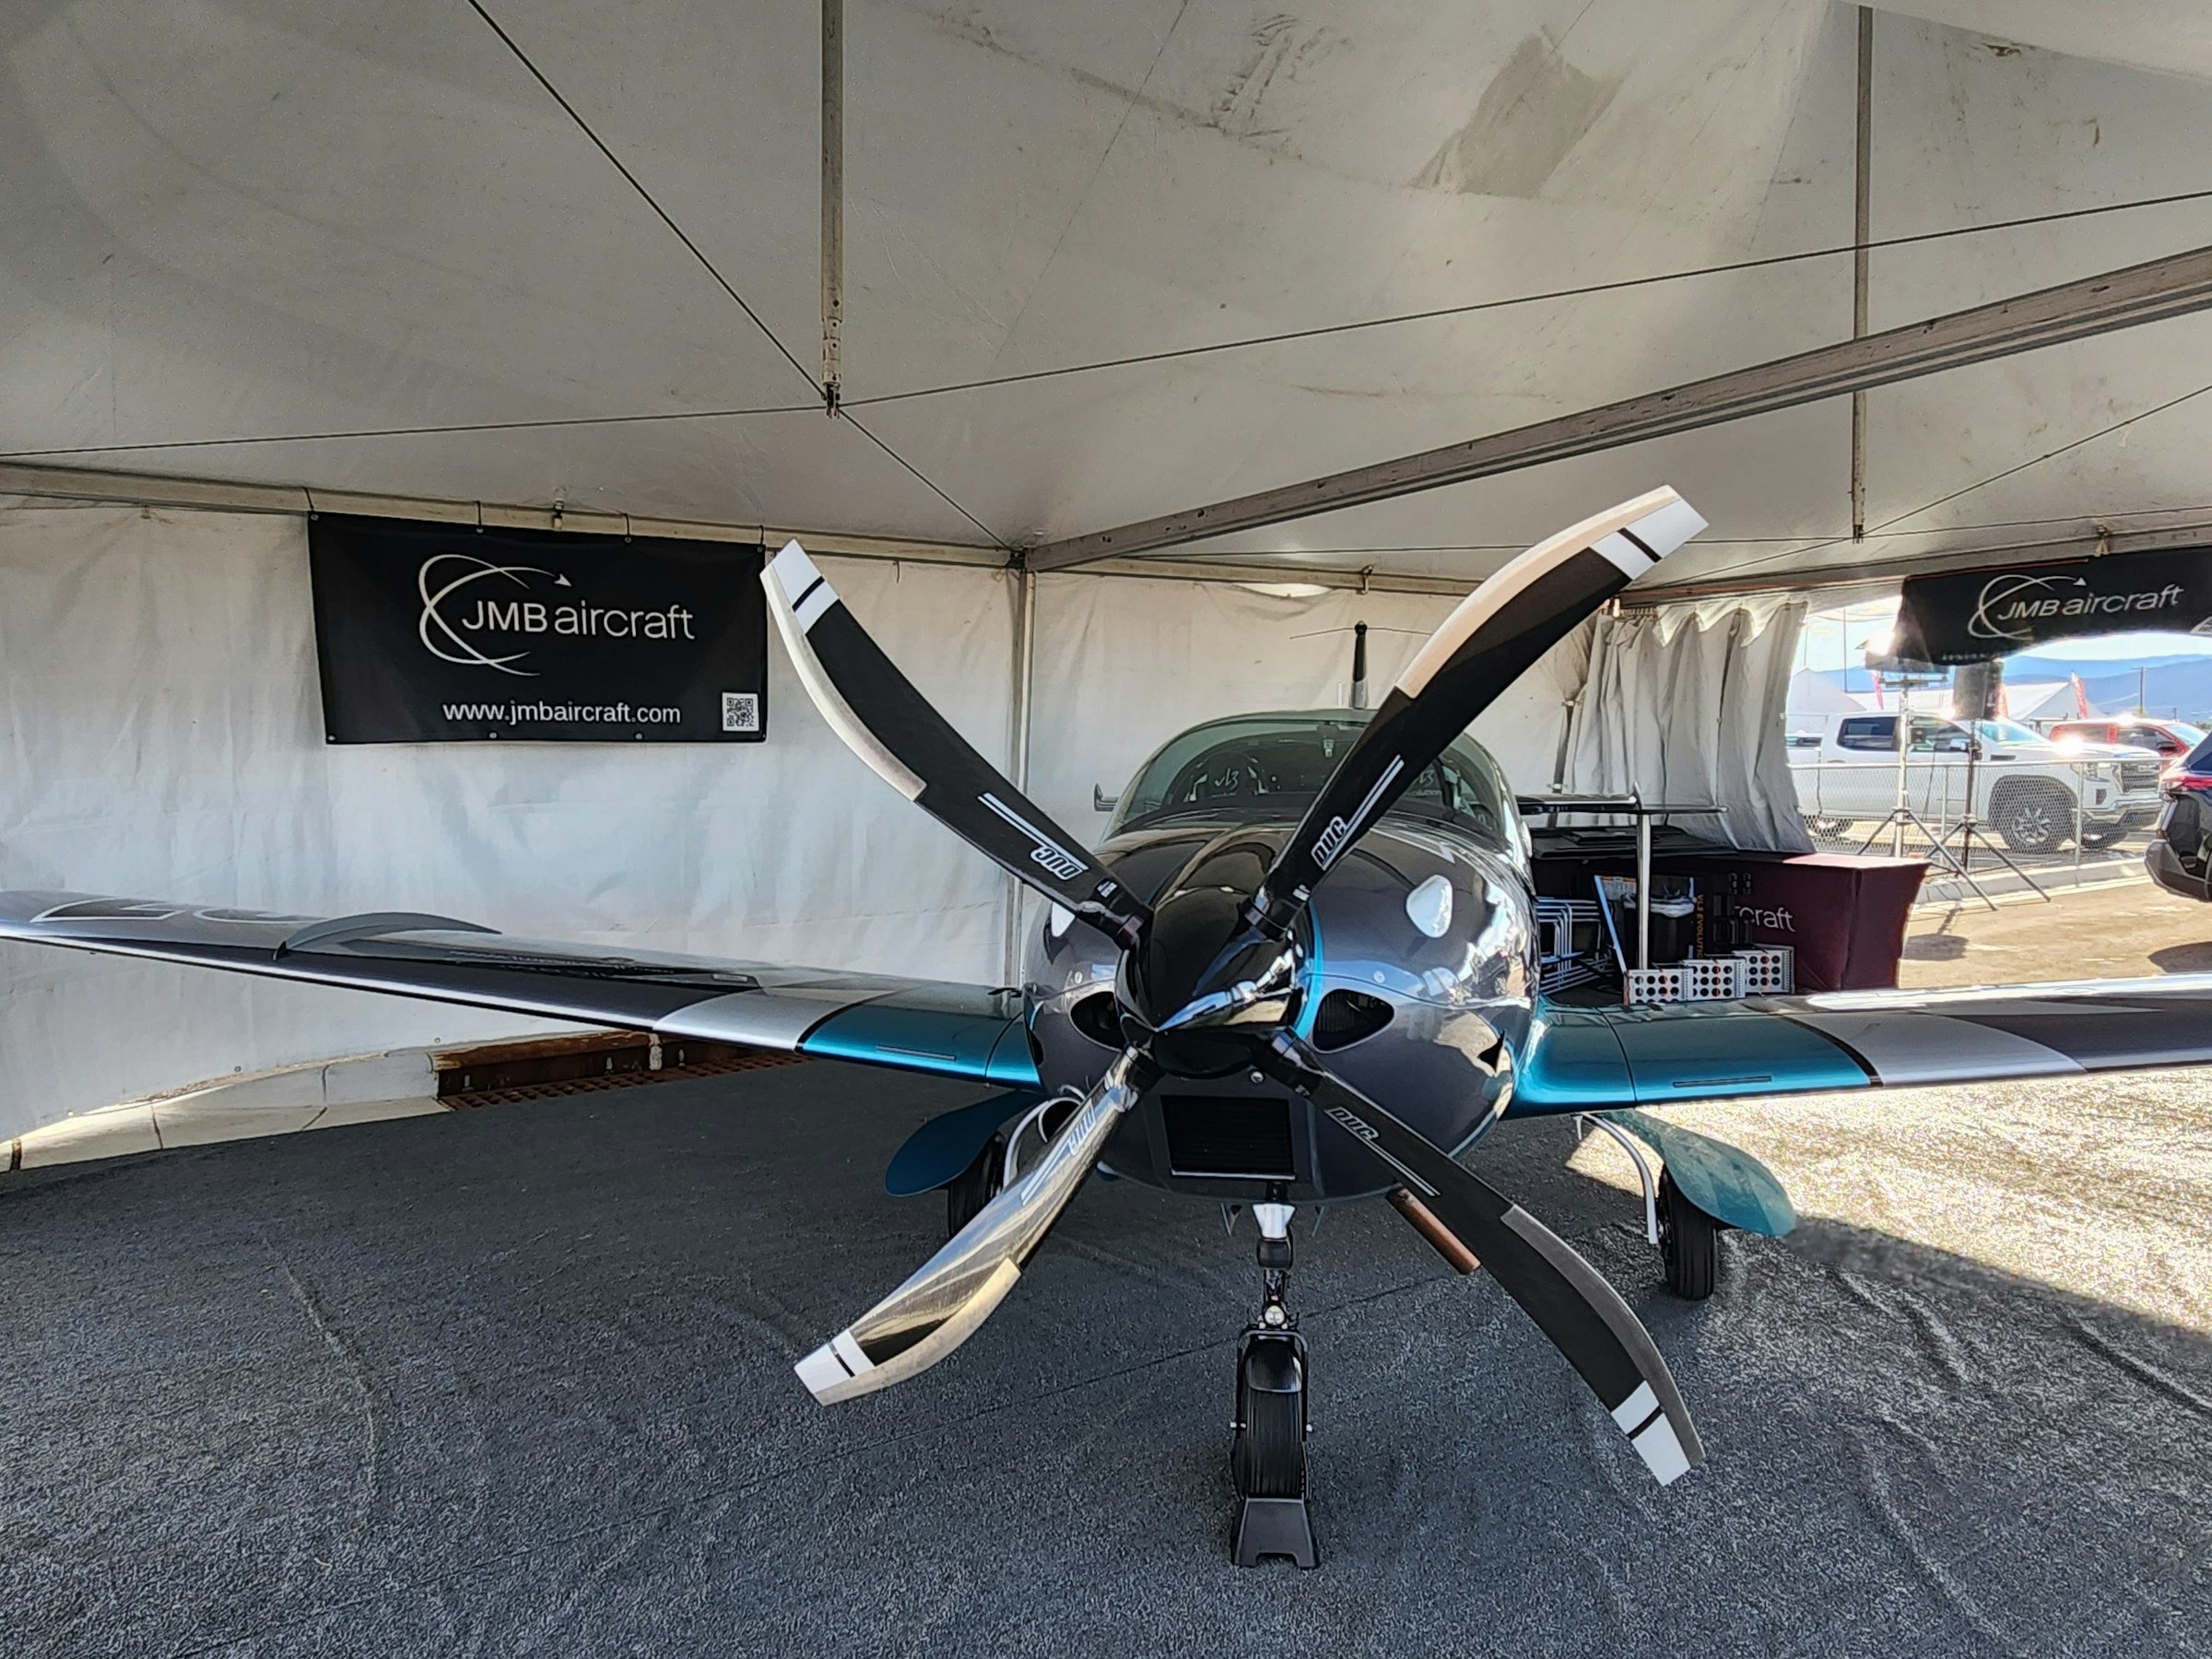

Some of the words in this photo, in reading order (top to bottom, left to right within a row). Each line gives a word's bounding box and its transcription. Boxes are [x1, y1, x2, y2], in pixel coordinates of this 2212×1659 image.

[461, 600, 547, 632] JMB
[554, 599, 695, 640] aircraft
[1997, 601, 2060, 620] JMB
[2062, 583, 2184, 614] aircraft
[442, 700, 681, 725] www.jmbaircraft.com
[1311, 816, 1347, 867] DUC
[1030, 845, 1084, 880] DUC
[1696, 913, 1704, 959] EVOLUTIO
[1735, 906, 1796, 933] craft
